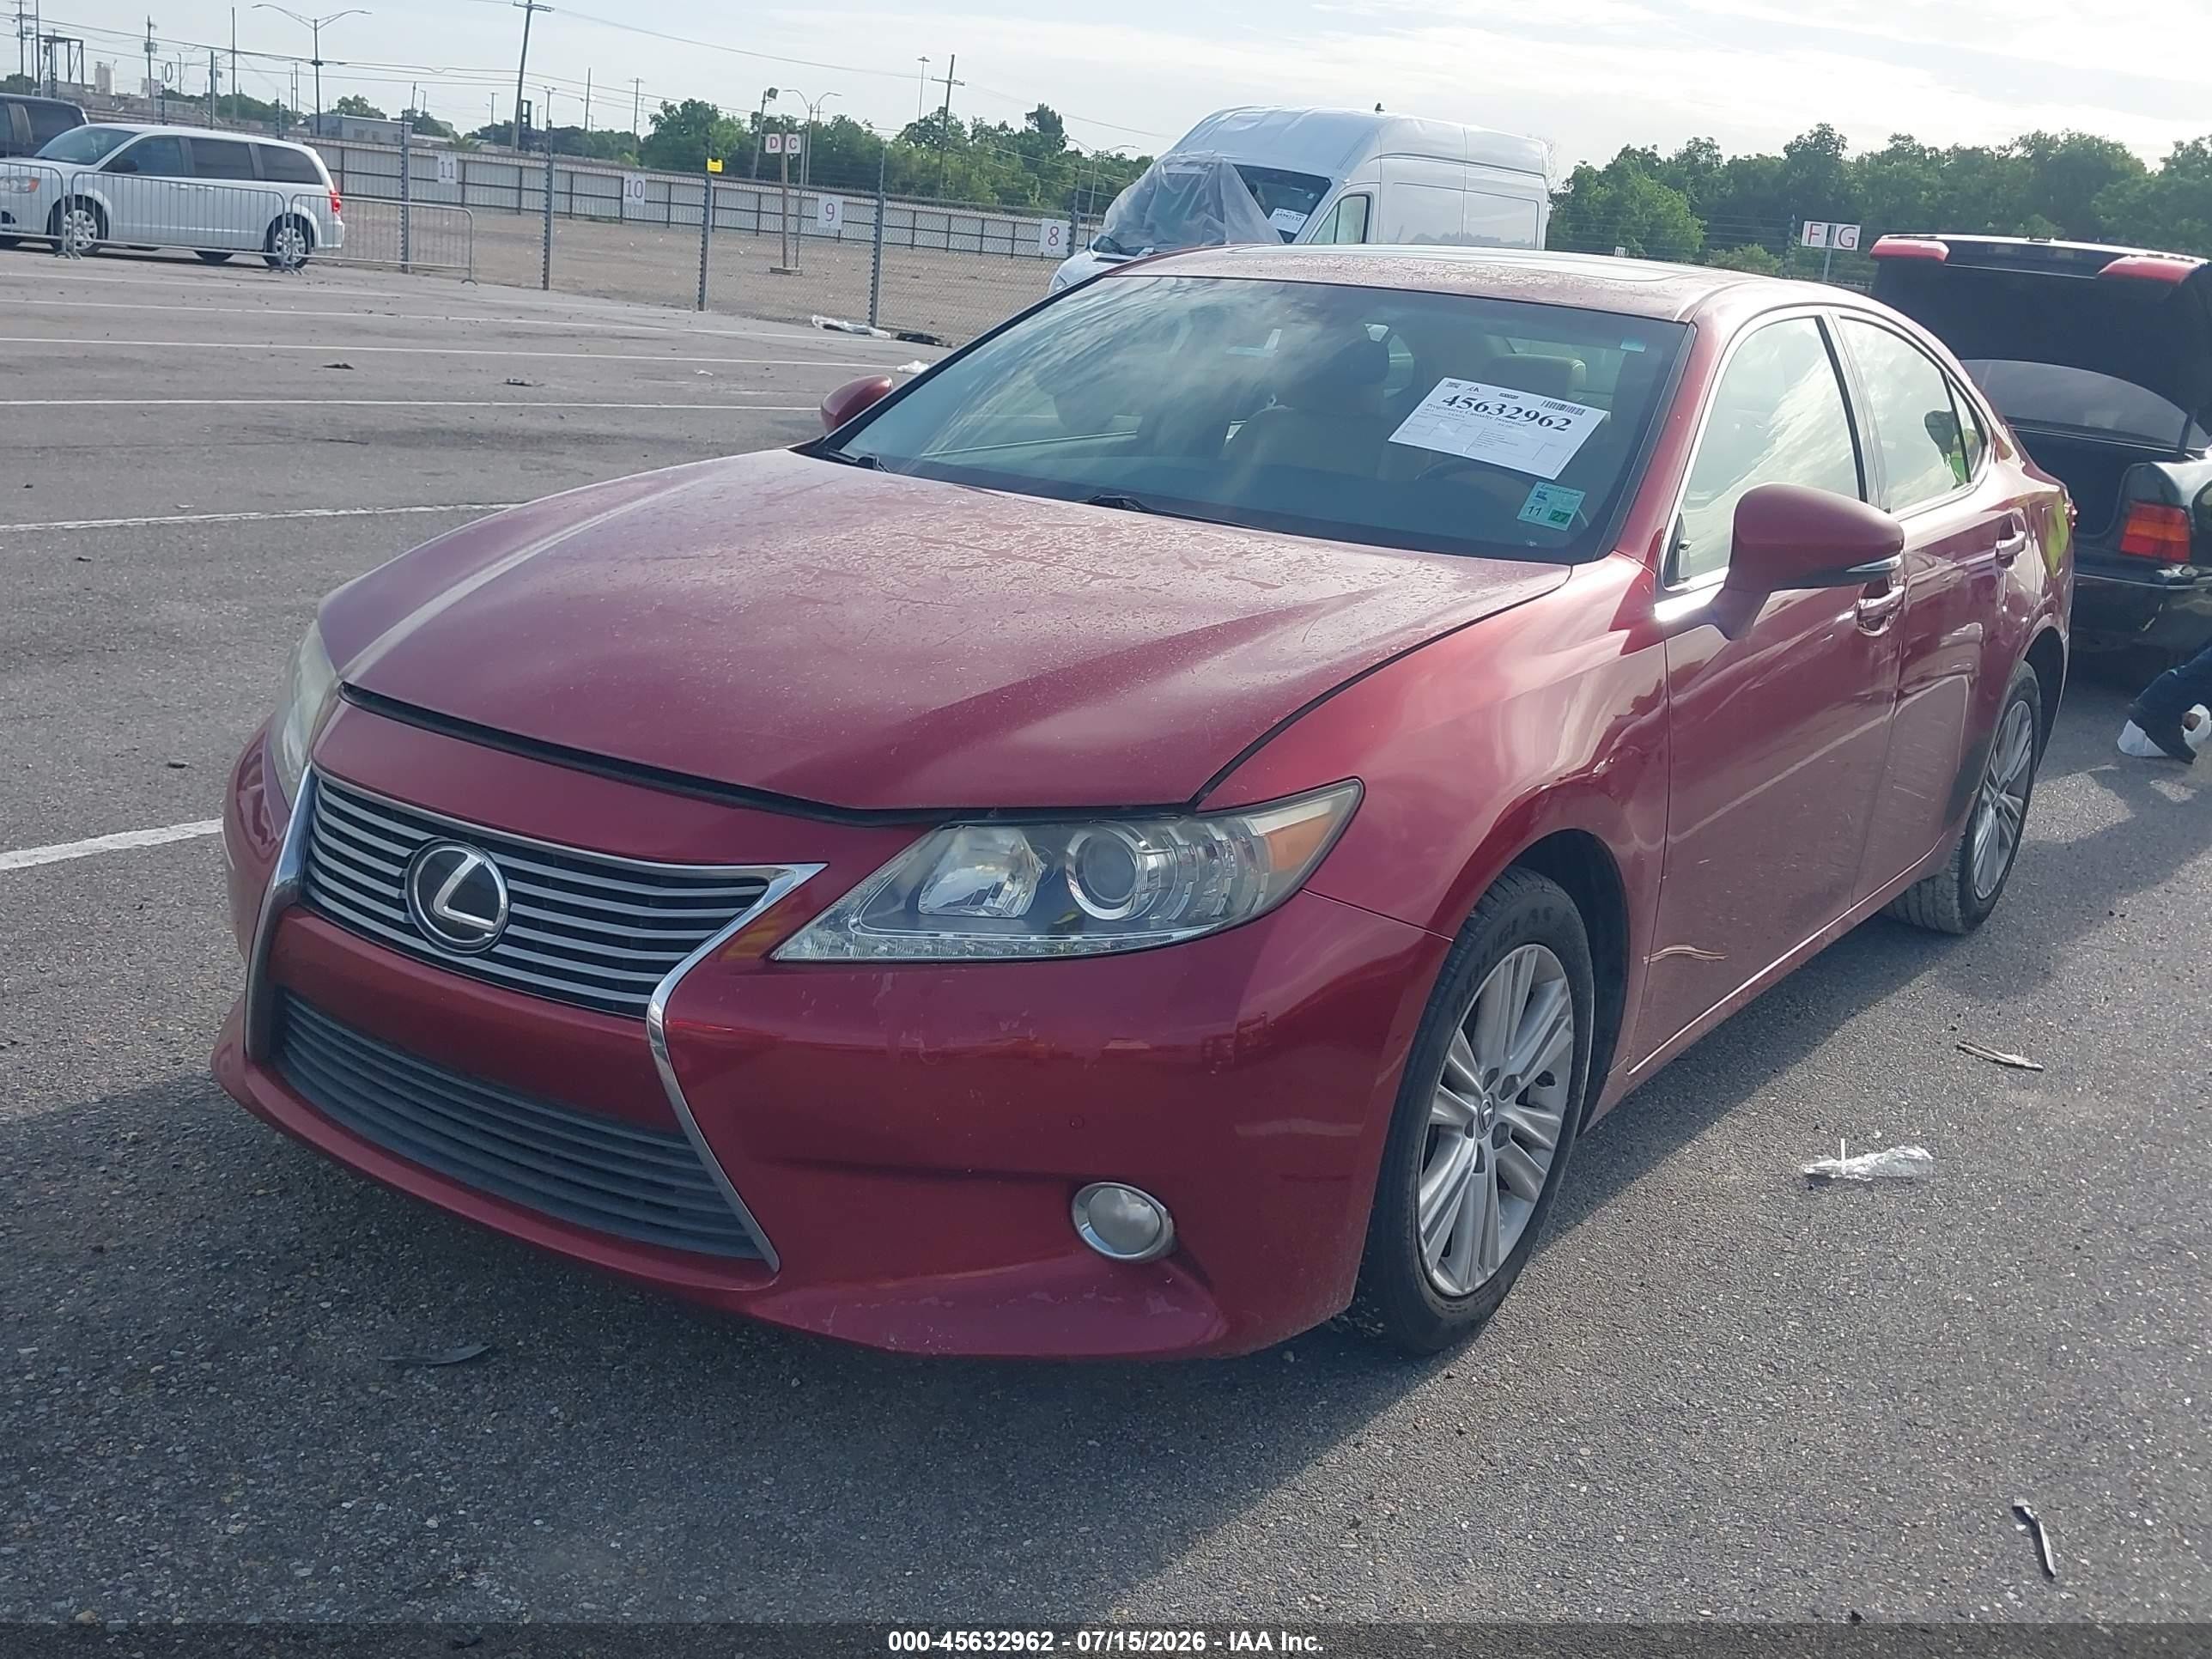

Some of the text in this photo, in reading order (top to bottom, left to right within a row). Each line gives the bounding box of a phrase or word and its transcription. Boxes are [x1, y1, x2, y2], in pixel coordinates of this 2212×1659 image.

[769, 137, 779, 149] D
[788, 137, 798, 150] C
[440, 161, 455, 179] 11
[625, 179, 644, 199] 10
[825, 203, 836, 222] 9
[1048, 225, 1060, 246] 8
[1808, 222, 1822, 246] F
[1838, 226, 1856, 249] G
[1442, 394, 1572, 431] 45632962
[1528, 505, 1542, 516] 11
